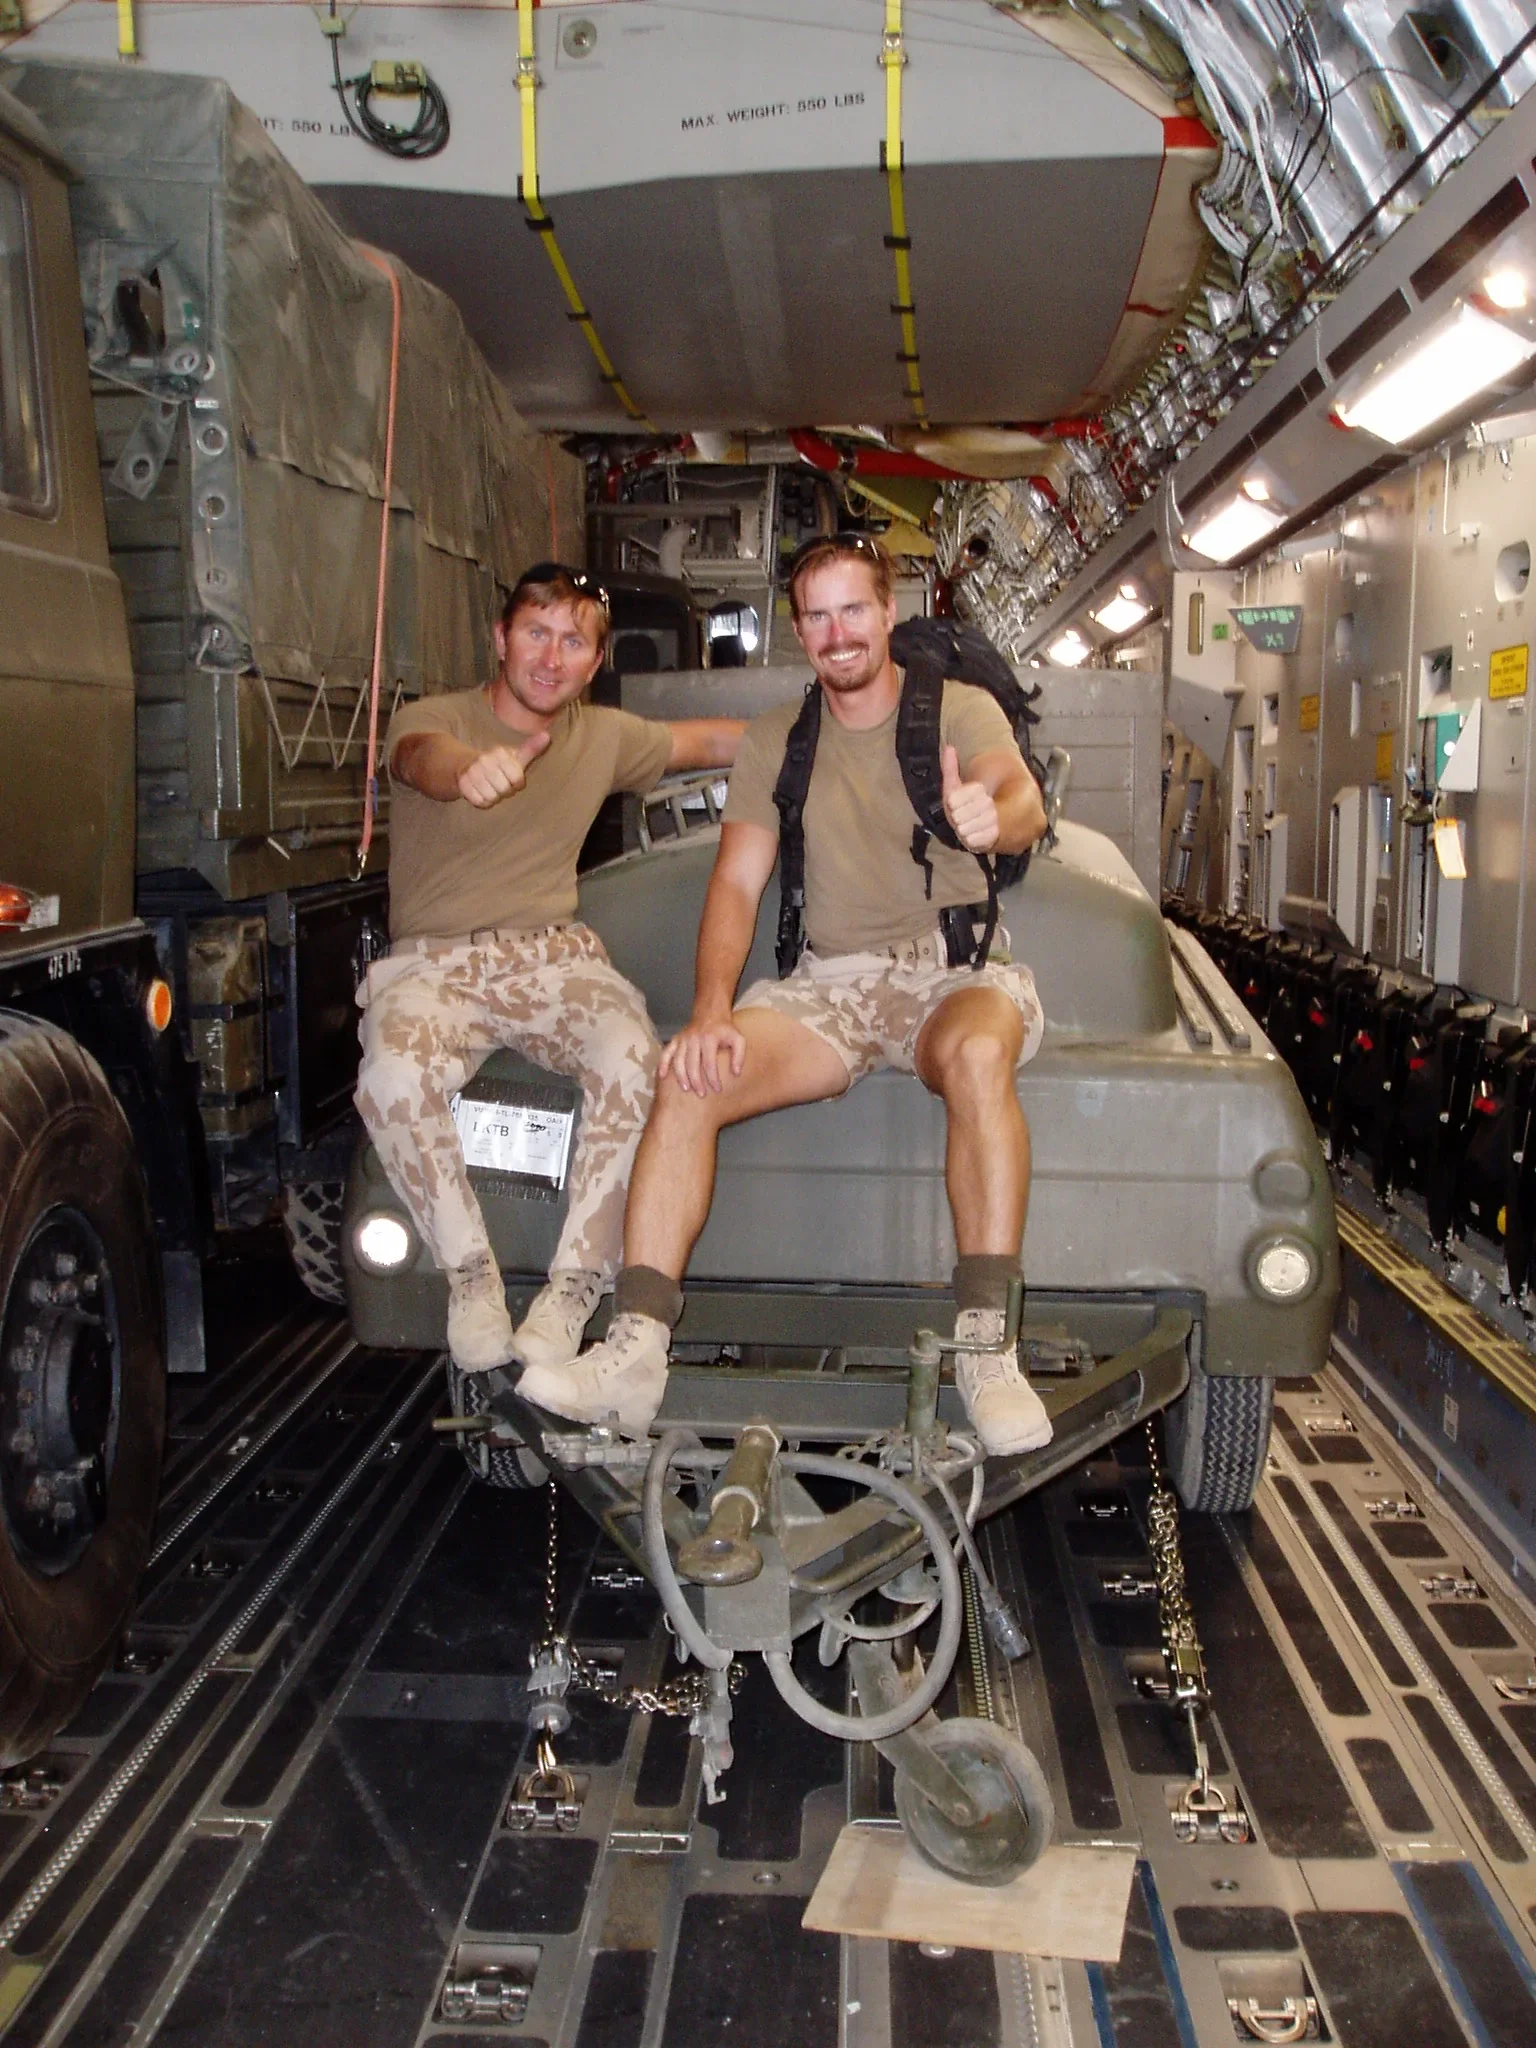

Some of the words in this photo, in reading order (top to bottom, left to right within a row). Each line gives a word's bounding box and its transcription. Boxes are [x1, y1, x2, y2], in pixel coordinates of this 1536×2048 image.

[681, 115, 719, 131] MAX.
[727, 103, 790, 123] WEIGHT:
[797, 96, 827, 112] 550
[834, 92, 866, 108] LBS
